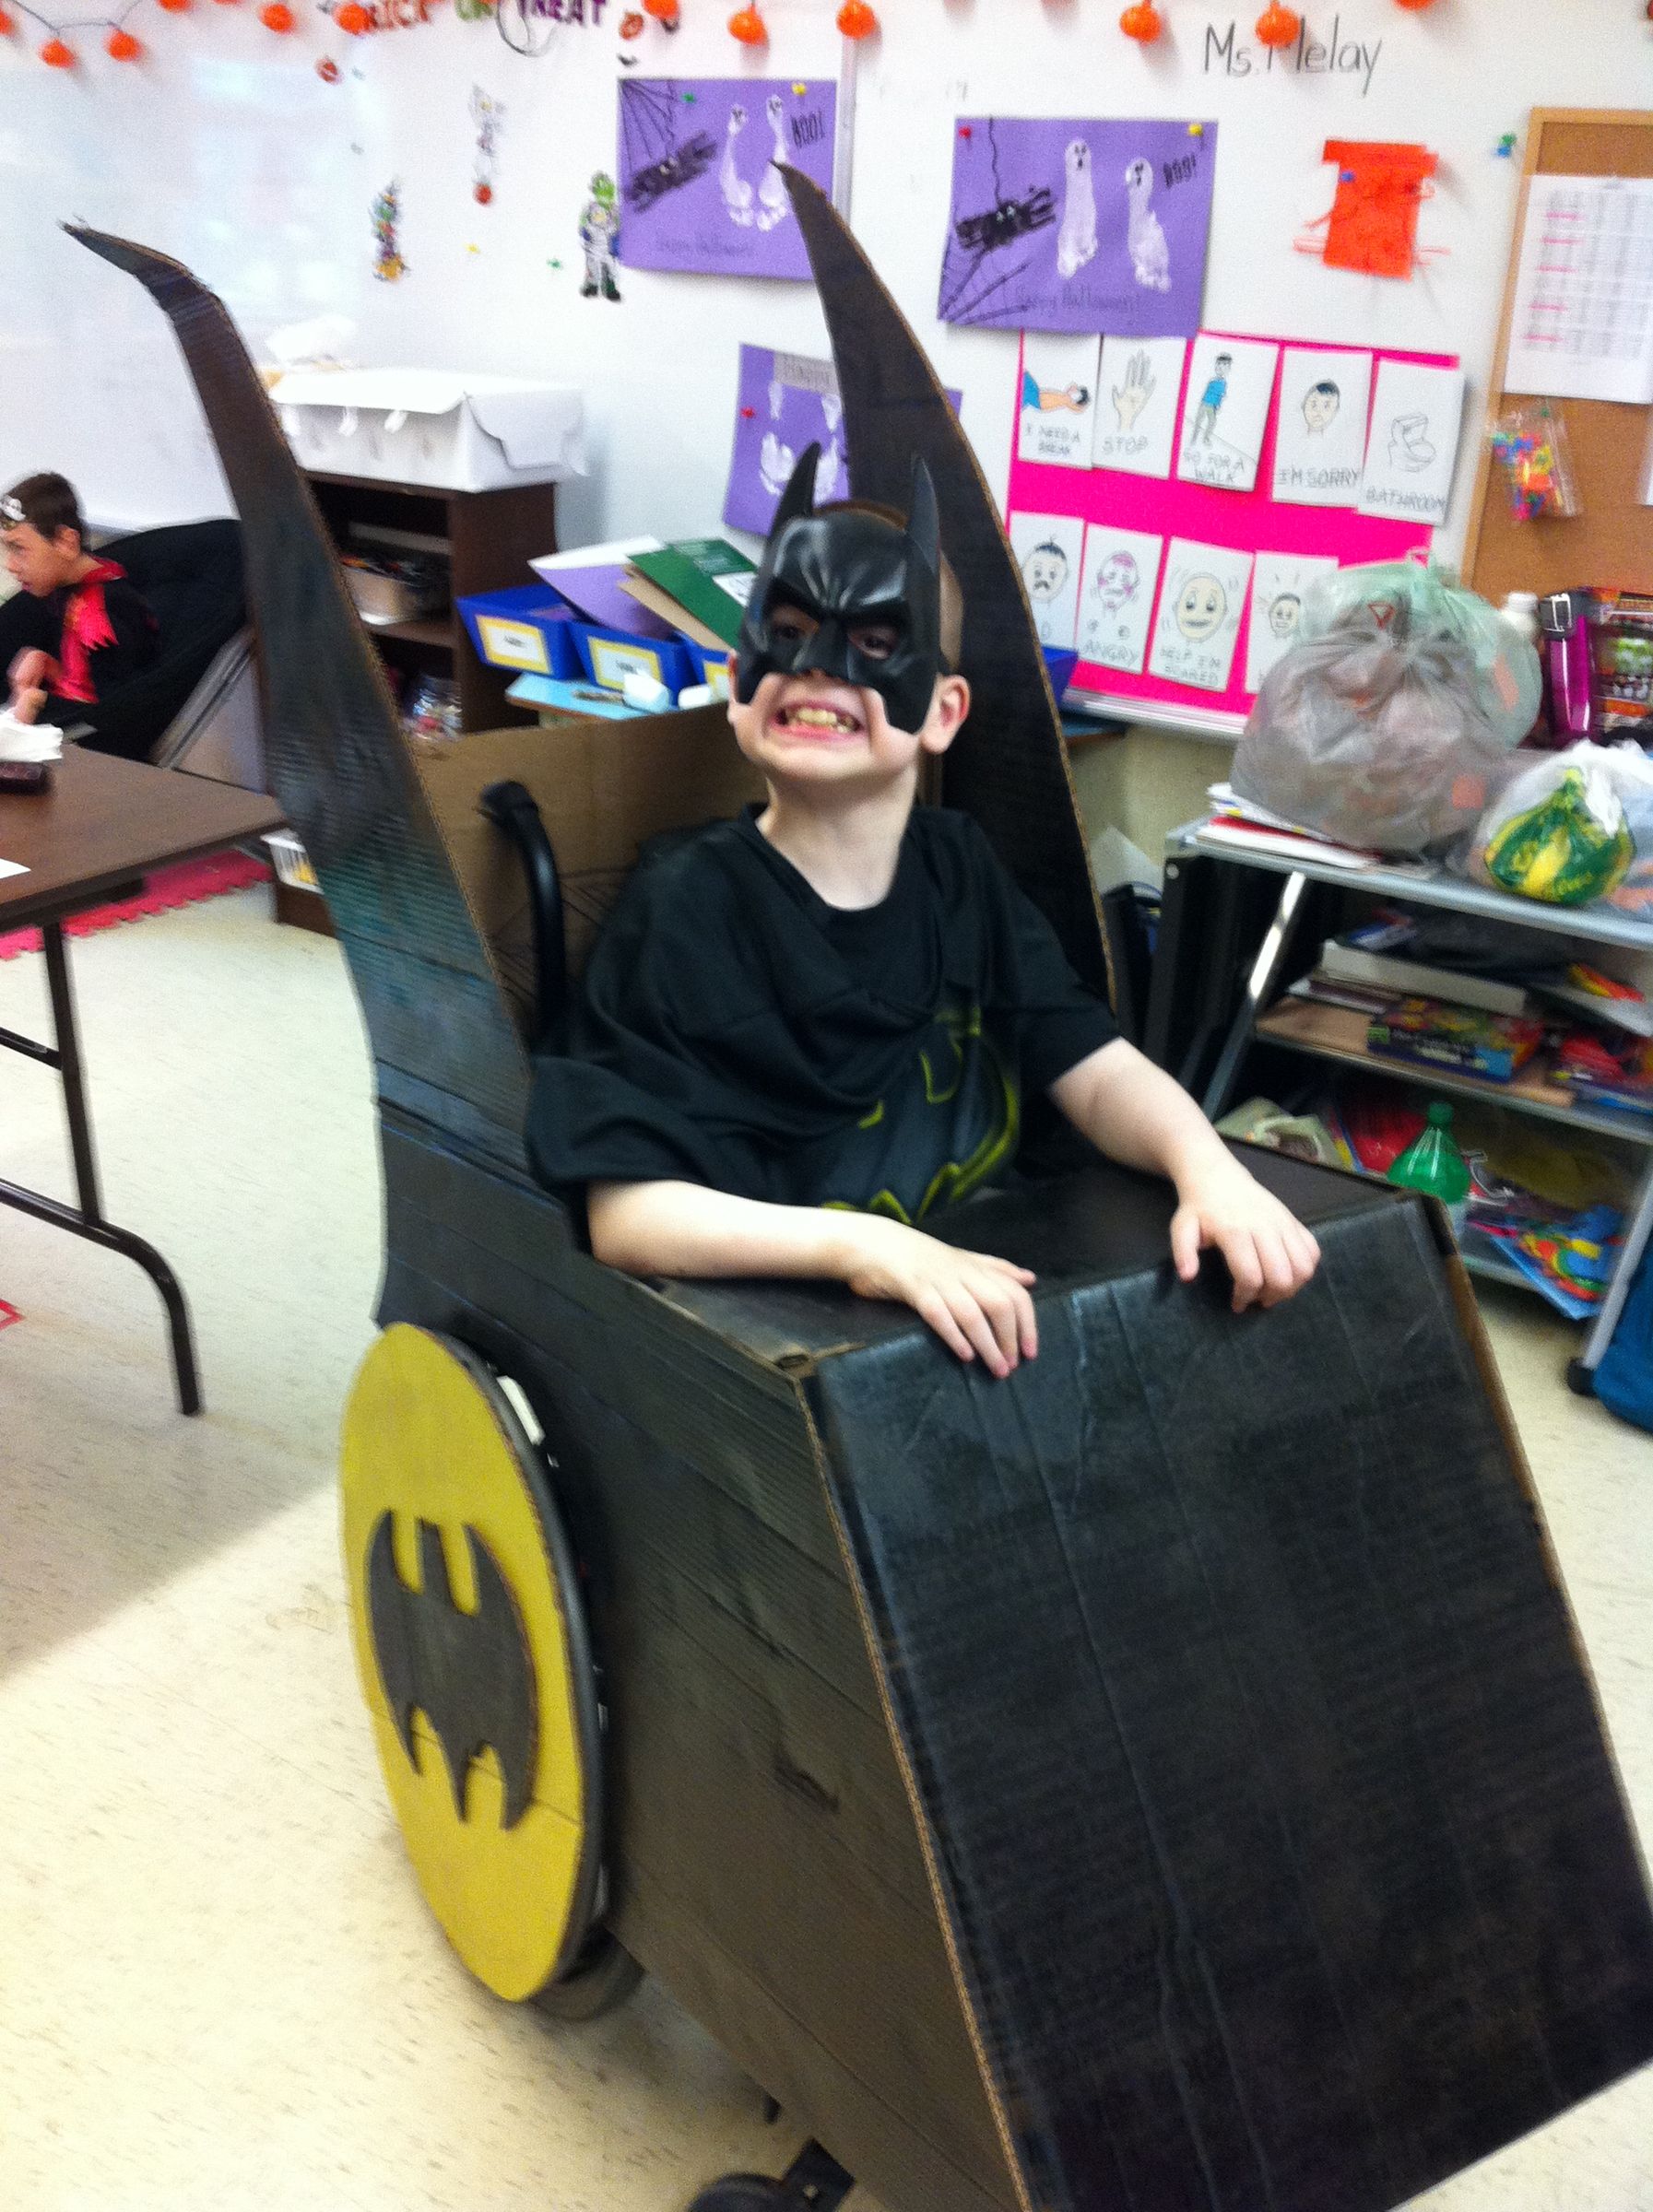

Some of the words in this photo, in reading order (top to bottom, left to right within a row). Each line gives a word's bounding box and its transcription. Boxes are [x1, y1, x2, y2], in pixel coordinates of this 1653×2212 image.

[1103, 436, 1149, 455] STOP
[1306, 467, 1357, 488] SORRY
[1082, 640, 1137, 667] ANGRY
